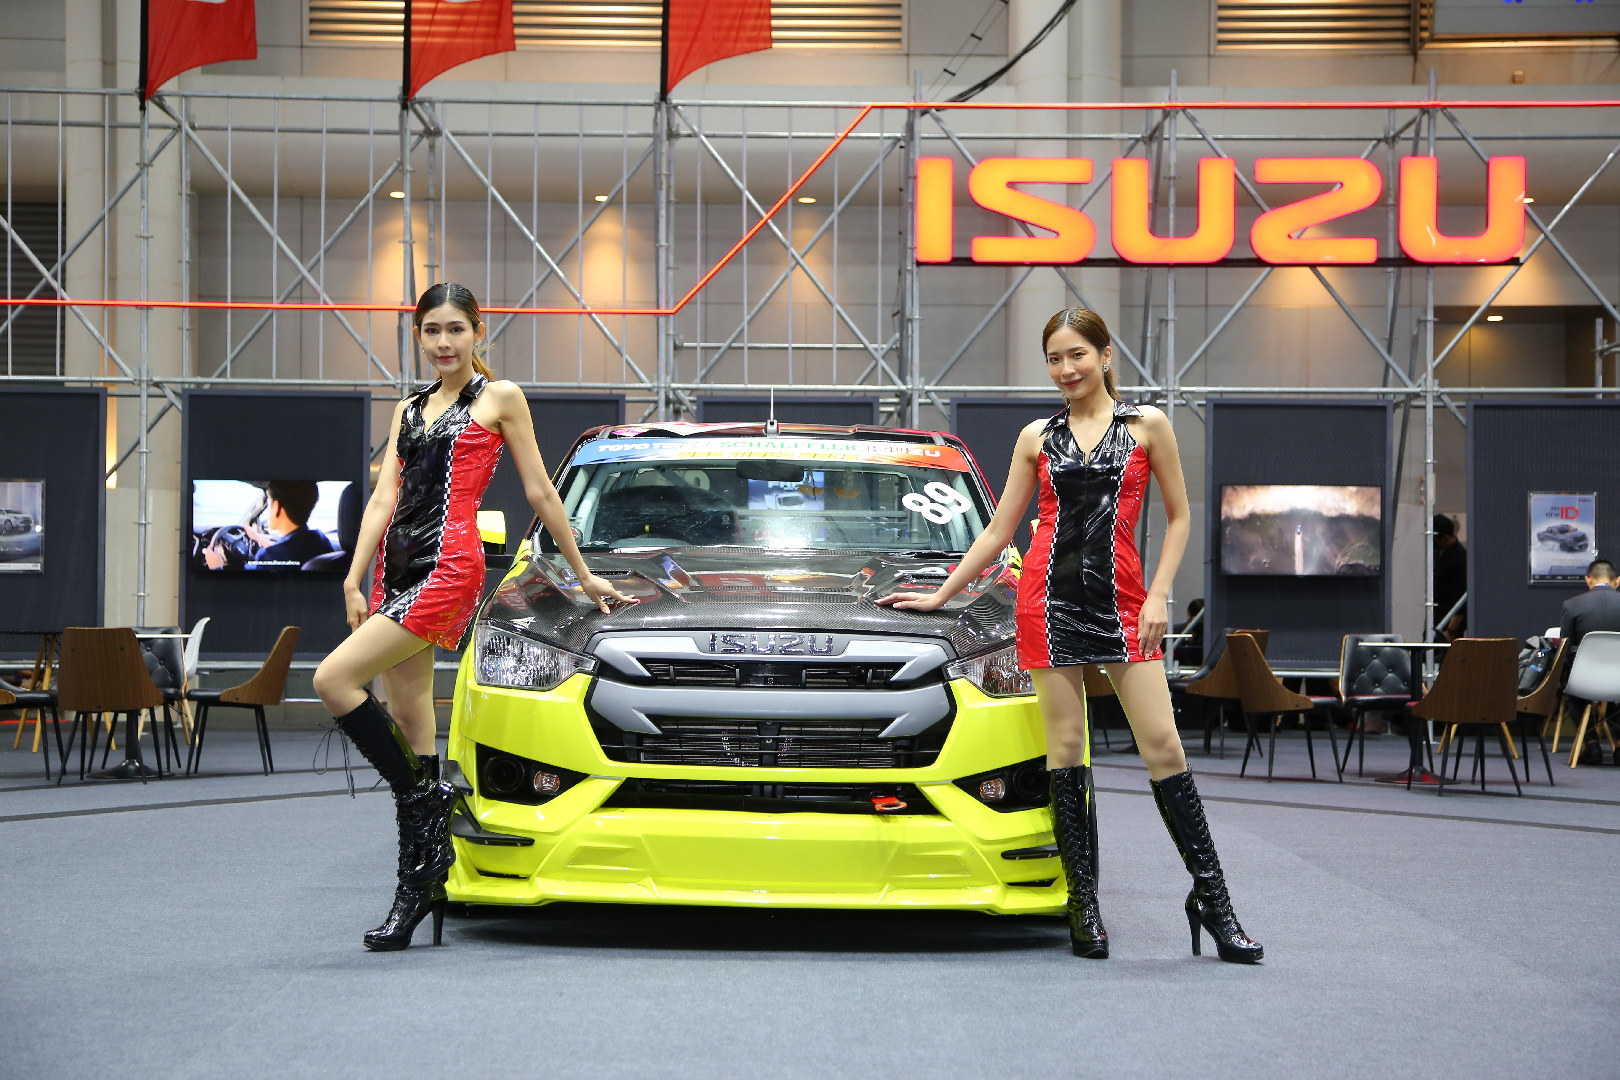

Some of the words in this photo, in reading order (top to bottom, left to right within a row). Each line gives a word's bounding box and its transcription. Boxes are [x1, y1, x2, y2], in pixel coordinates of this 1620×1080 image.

[915, 156, 1526, 264] ISUZU
[598, 442, 650, 452] TOYO
[720, 440, 857, 451] SCHAEFFLER
[902, 481, 972, 525] 89
[1560, 506, 1579, 520] ID
[709, 633, 834, 655] ISUZU
